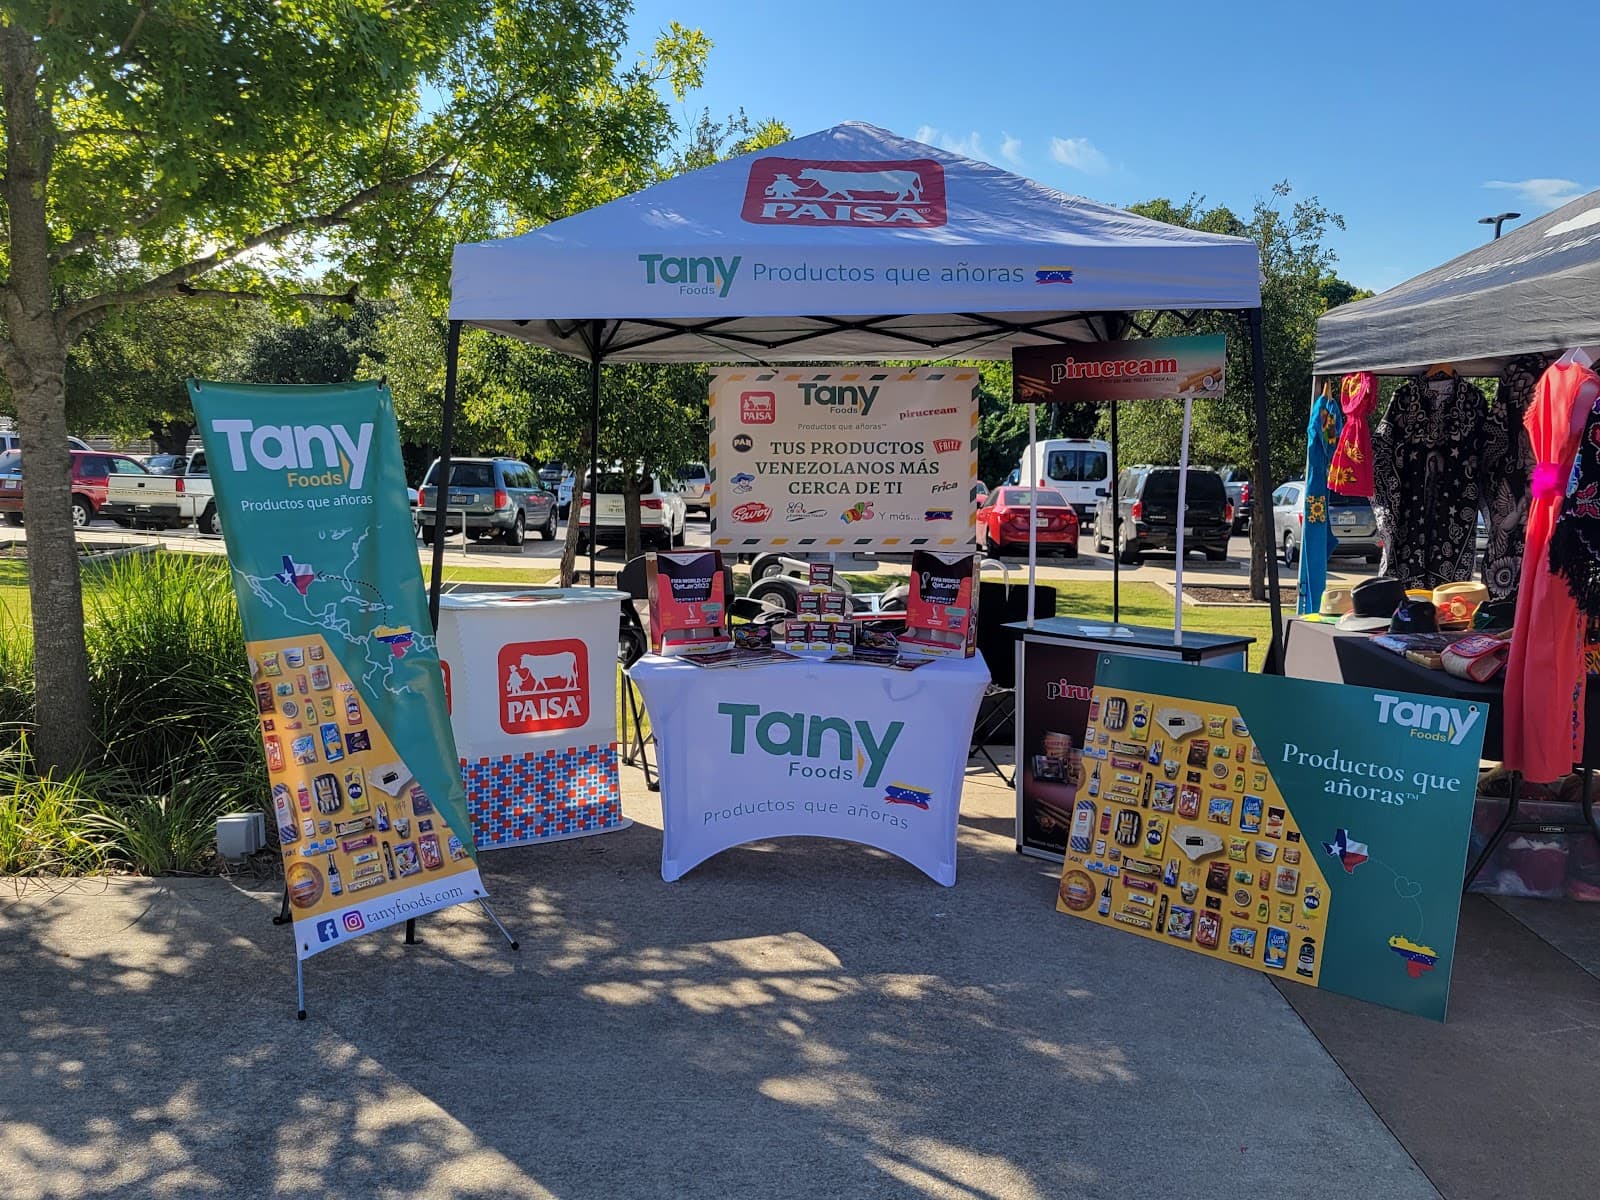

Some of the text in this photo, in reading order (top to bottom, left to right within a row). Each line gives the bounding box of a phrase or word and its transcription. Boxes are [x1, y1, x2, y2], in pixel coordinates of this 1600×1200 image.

[638, 254, 742, 298] Tany
[753, 262, 1024, 286] Productos que añoras
[679, 285, 715, 295] Foods
[1051, 357, 1178, 384] pirucream
[797, 383, 880, 416] Tany
[743, 411, 772, 421] PAISA
[899, 407, 957, 420] pirucream
[838, 424, 853, 432] que
[770, 441, 924, 455] TUS PRODUCTOS
[939, 440, 960, 451] FRITZ
[211, 419, 374, 490] Tany
[756, 458, 939, 475] VENEZOLANOS MÁS
[287, 472, 343, 488] Foods
[788, 482, 903, 495] CERCA DE TI
[932, 481, 958, 494] Frica
[241, 494, 373, 512] Productos que añoras
[733, 507, 772, 521] Savoy
[879, 512, 887, 520] Y
[1373, 694, 1481, 745] Tany
[1410, 729, 1447, 743] Foods
[718, 702, 905, 788] Tany
[788, 762, 853, 780] Foods
[1282, 743, 1461, 795] Productos que
[703, 799, 908, 830] Productos que añoras
[366, 887, 463, 923] tanyfoods.com
